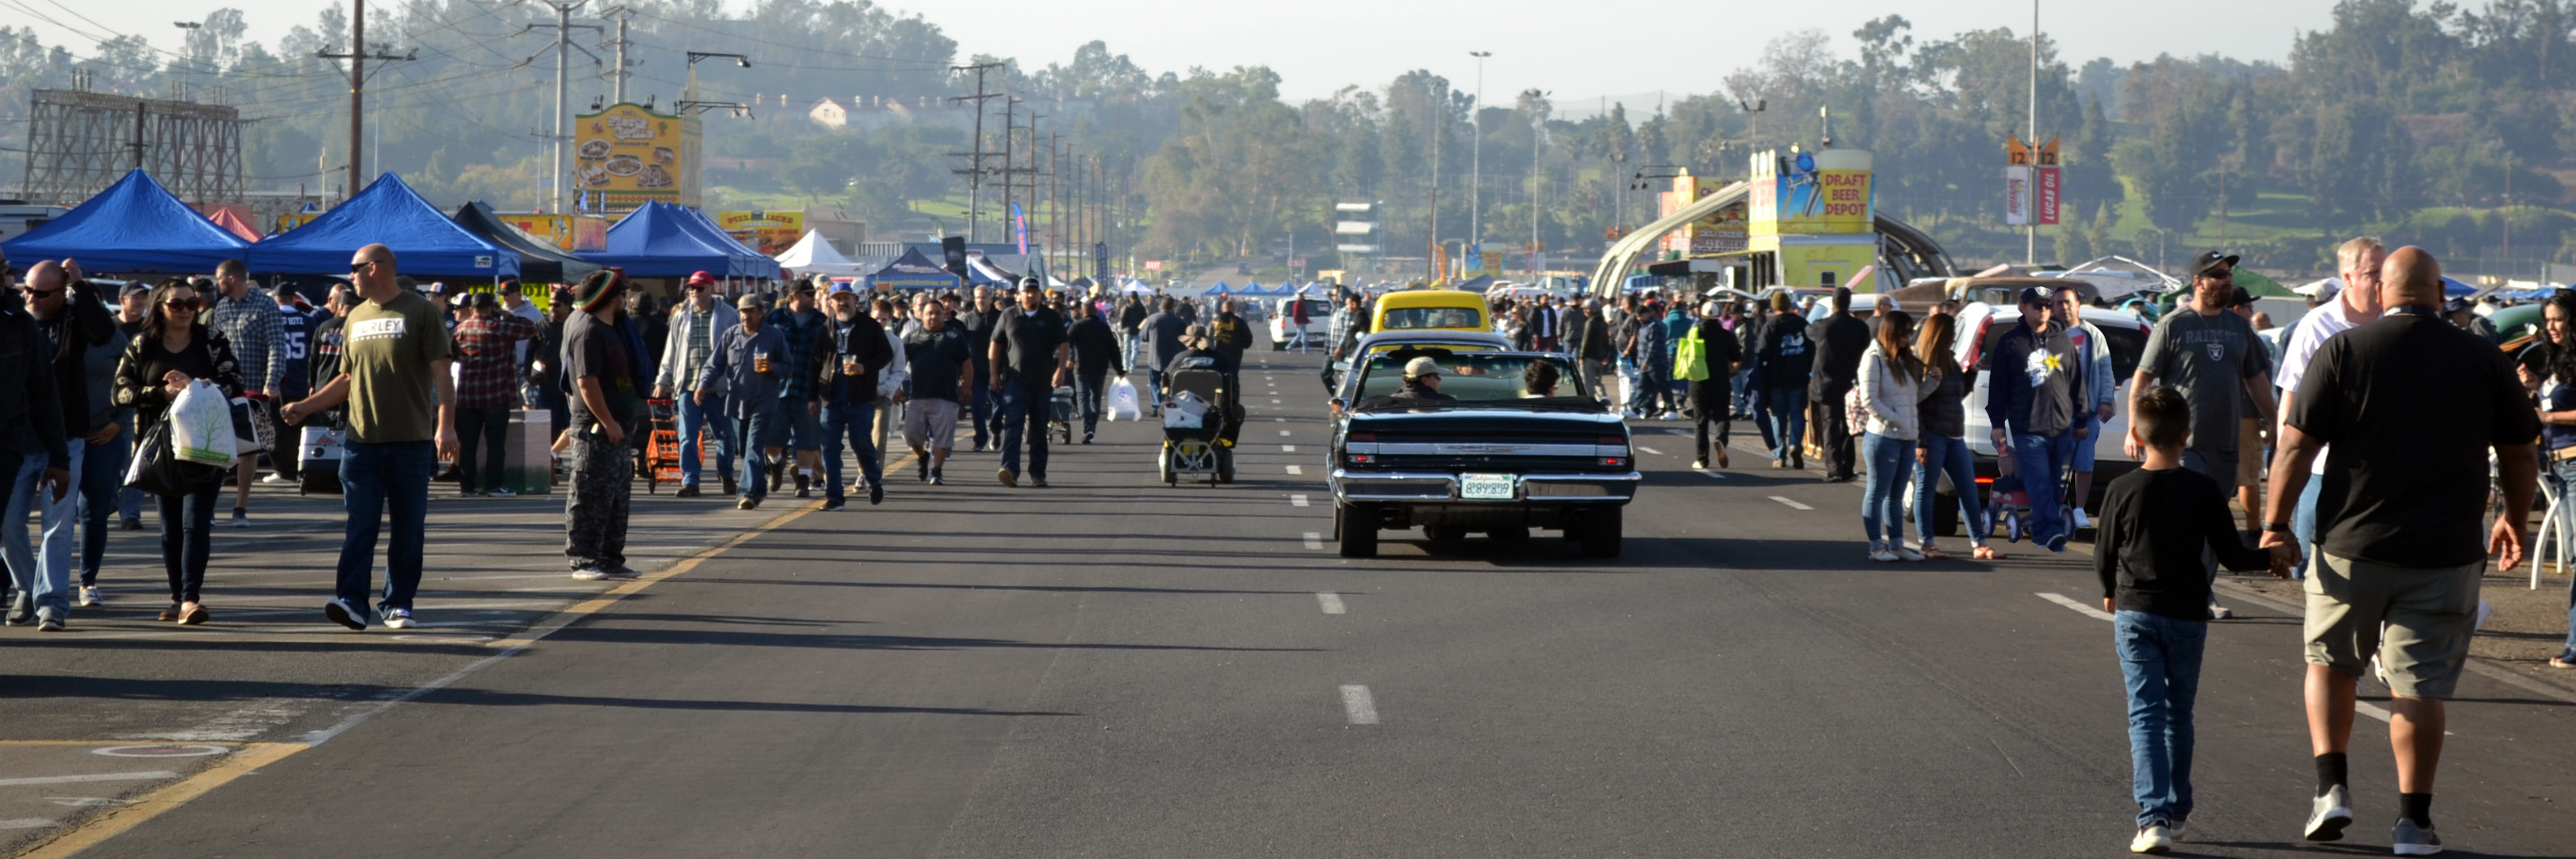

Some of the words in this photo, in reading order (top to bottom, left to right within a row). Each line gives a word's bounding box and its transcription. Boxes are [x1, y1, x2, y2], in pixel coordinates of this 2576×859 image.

[2011, 151, 2026, 165] 12
[2040, 151, 2055, 165] 12
[1825, 174, 1867, 186] DRAFT
[2045, 173, 2055, 188] OIL
[1832, 188, 1860, 201] BEER
[1825, 203, 1866, 215] DEPOT
[2045, 189, 2055, 221] LUCAS
[1146, 260, 1161, 269] EXIT
